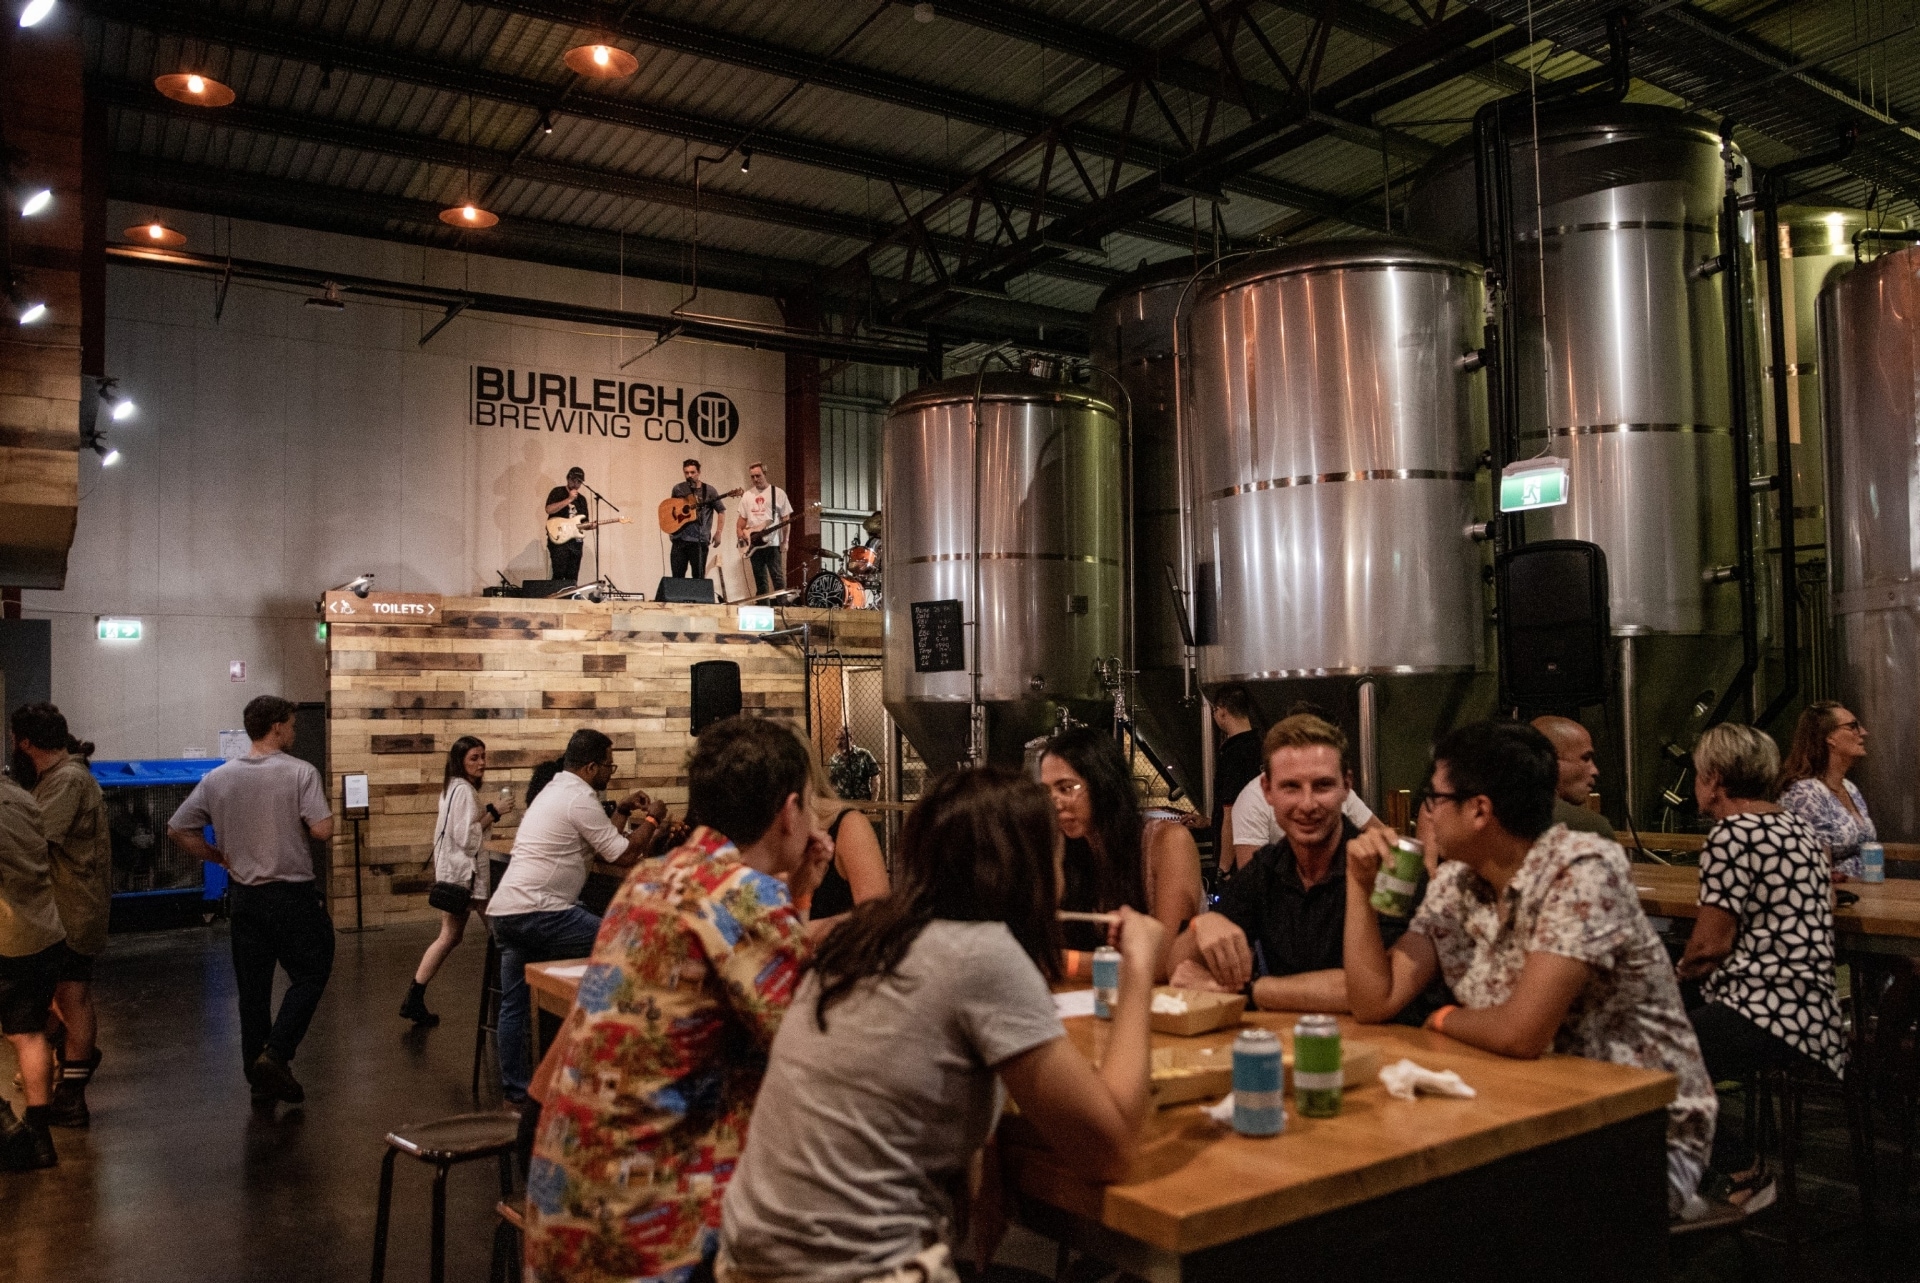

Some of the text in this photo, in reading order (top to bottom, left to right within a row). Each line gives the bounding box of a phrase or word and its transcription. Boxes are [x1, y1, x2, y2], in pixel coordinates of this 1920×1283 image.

[476, 366, 684, 420] BURLEIGH
[476, 401, 689, 444] BREWING CO.
[372, 603, 425, 615] TOILETS
